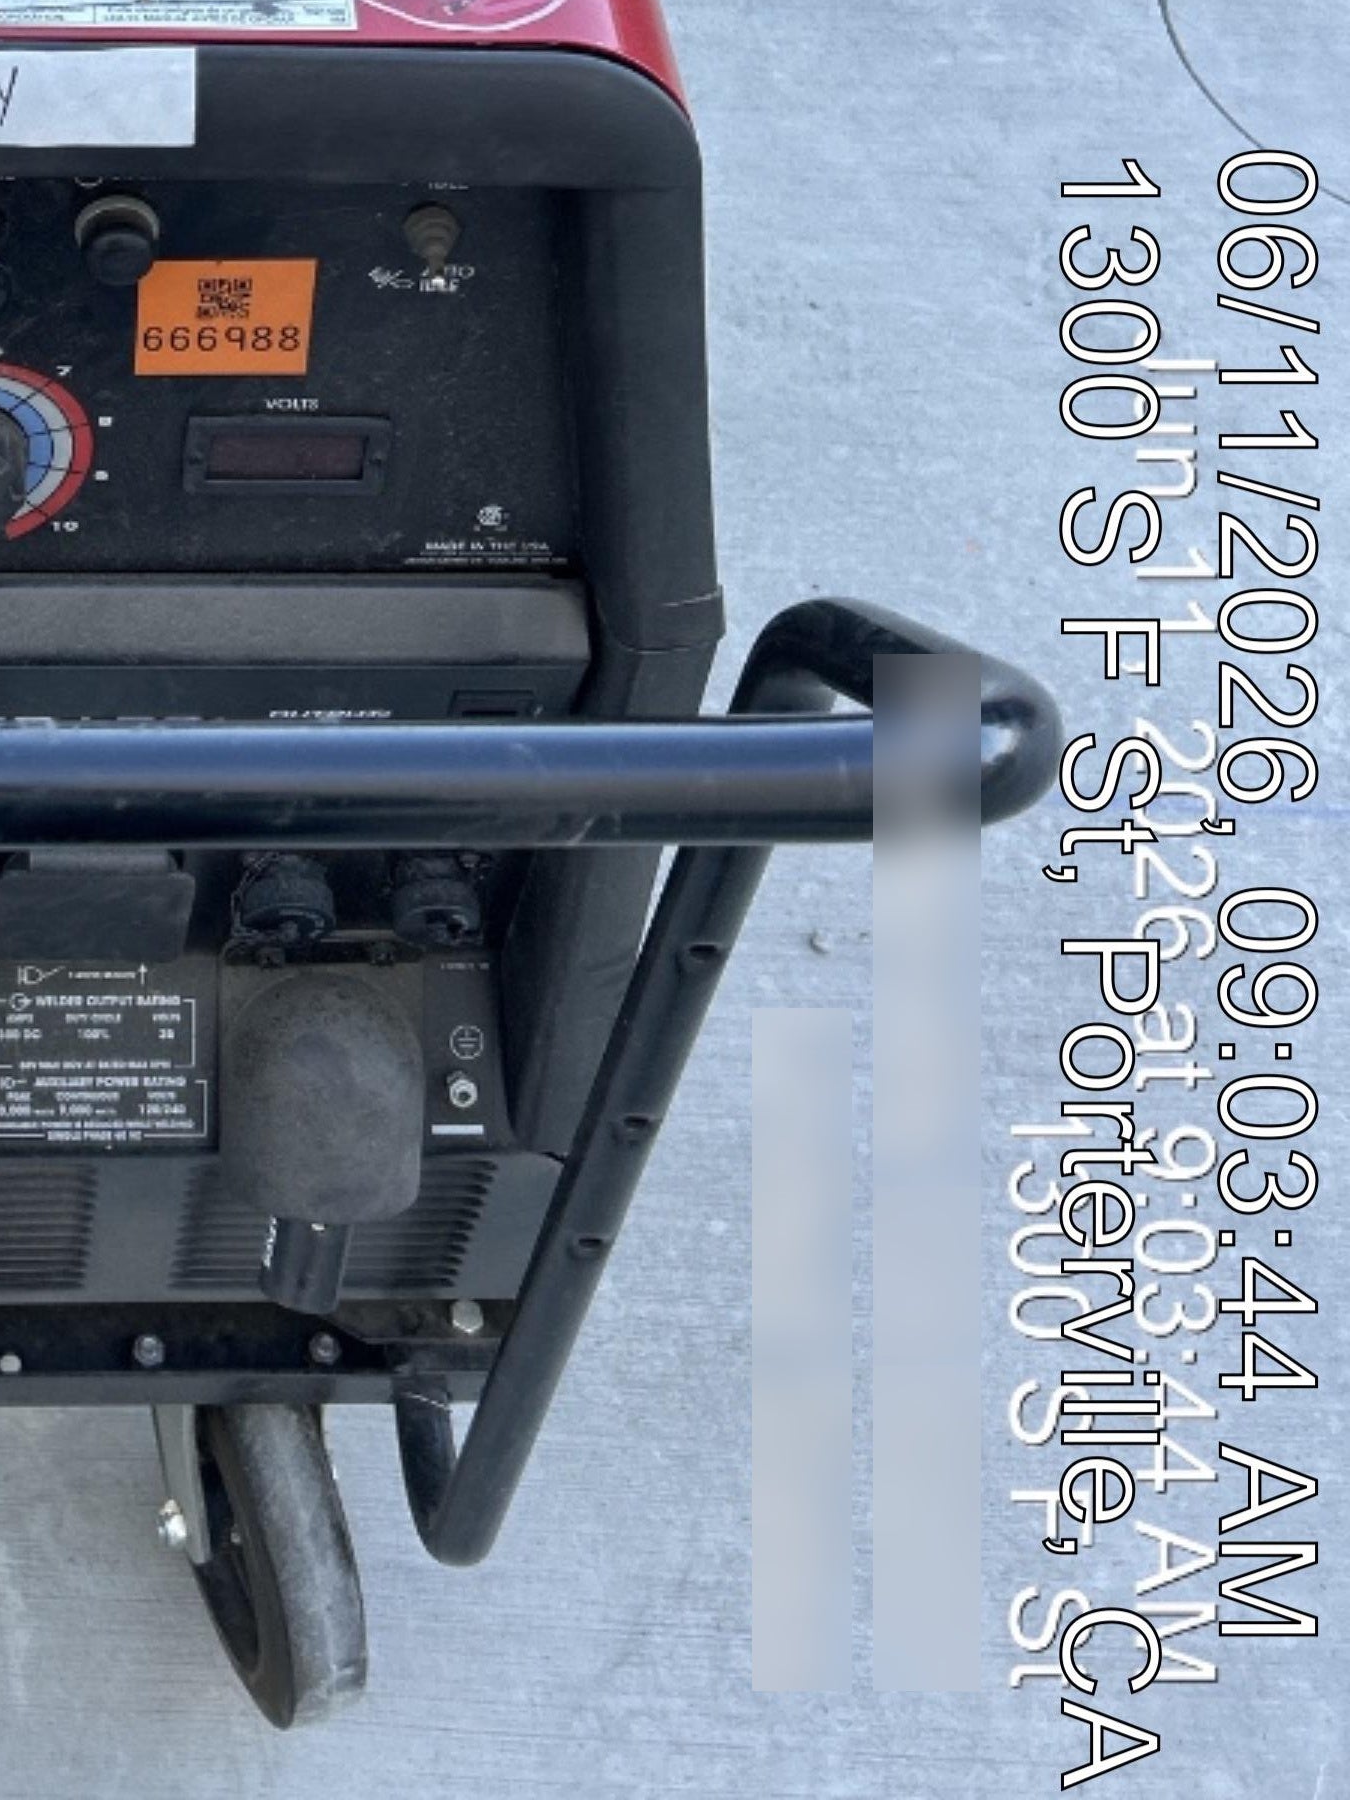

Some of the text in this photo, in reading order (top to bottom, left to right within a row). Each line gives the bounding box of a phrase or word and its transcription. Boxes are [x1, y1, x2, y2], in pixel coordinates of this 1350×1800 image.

[142, 325, 301, 352] 666988
[264, 397, 320, 411] VOLTS
[52, 520, 79, 533] 10
